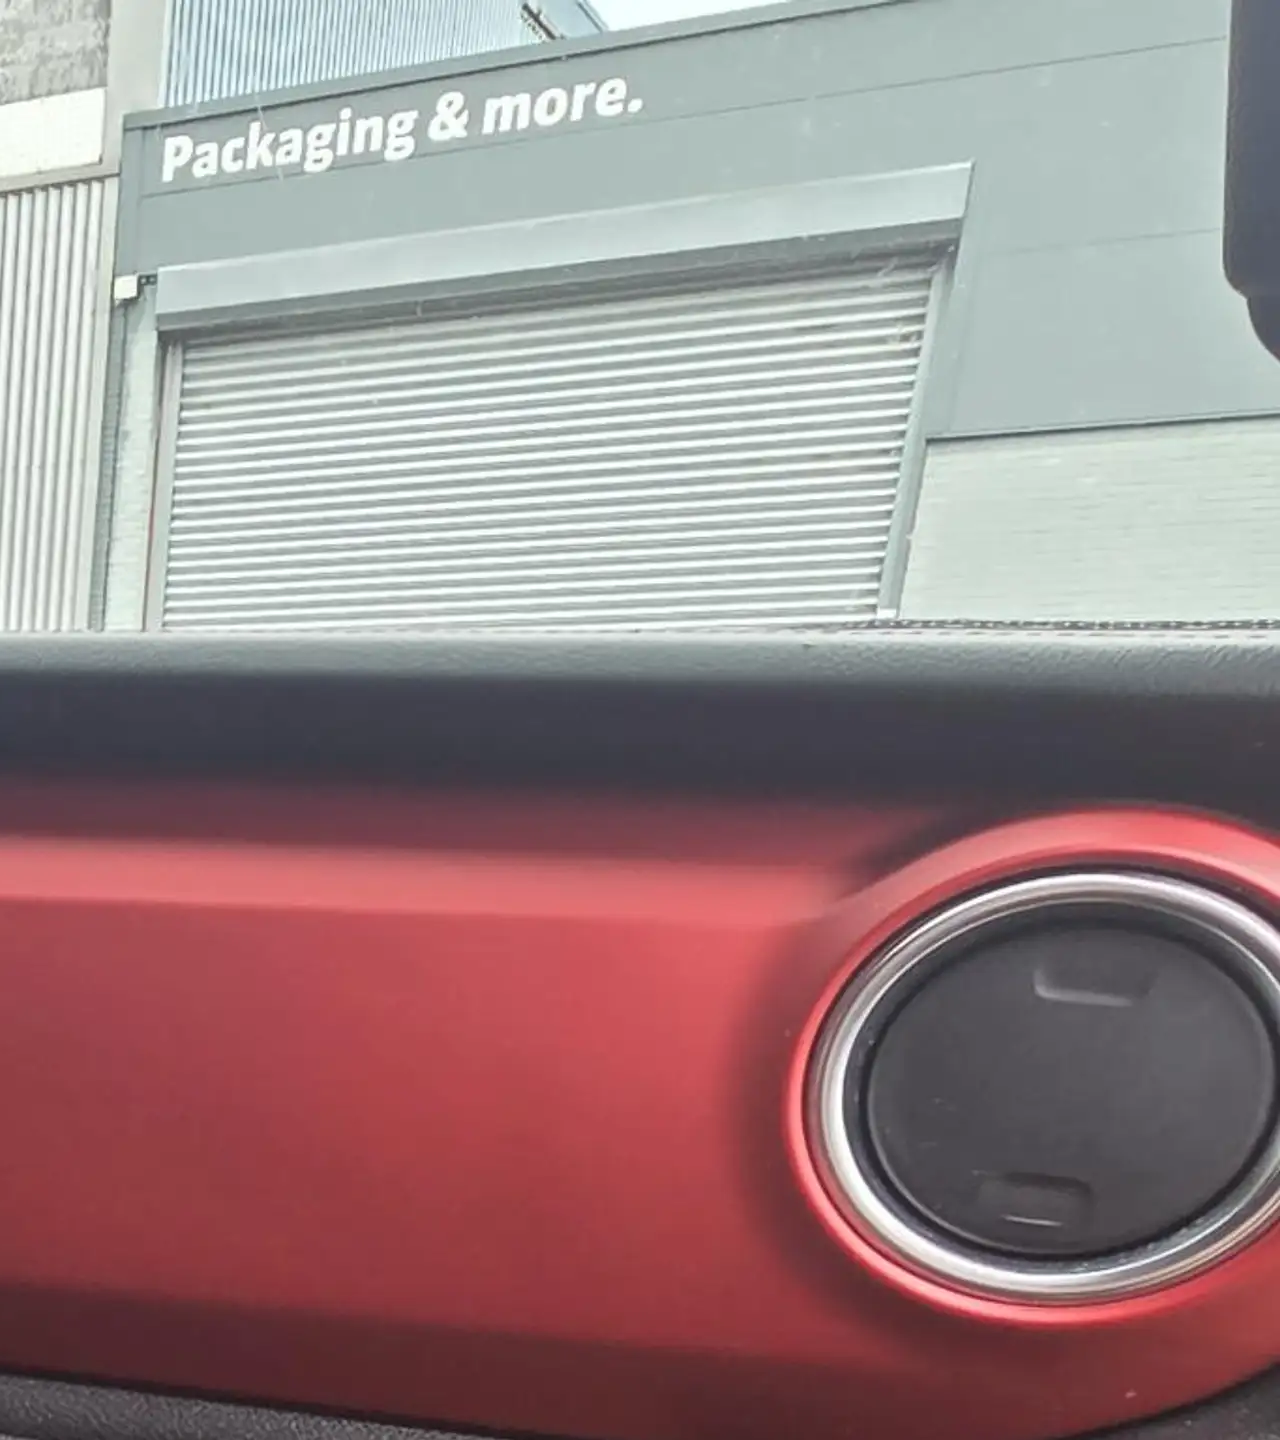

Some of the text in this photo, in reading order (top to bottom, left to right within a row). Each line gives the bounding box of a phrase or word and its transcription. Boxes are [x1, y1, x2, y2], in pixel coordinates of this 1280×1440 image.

[161, 77, 644, 183] Packaging & more.
